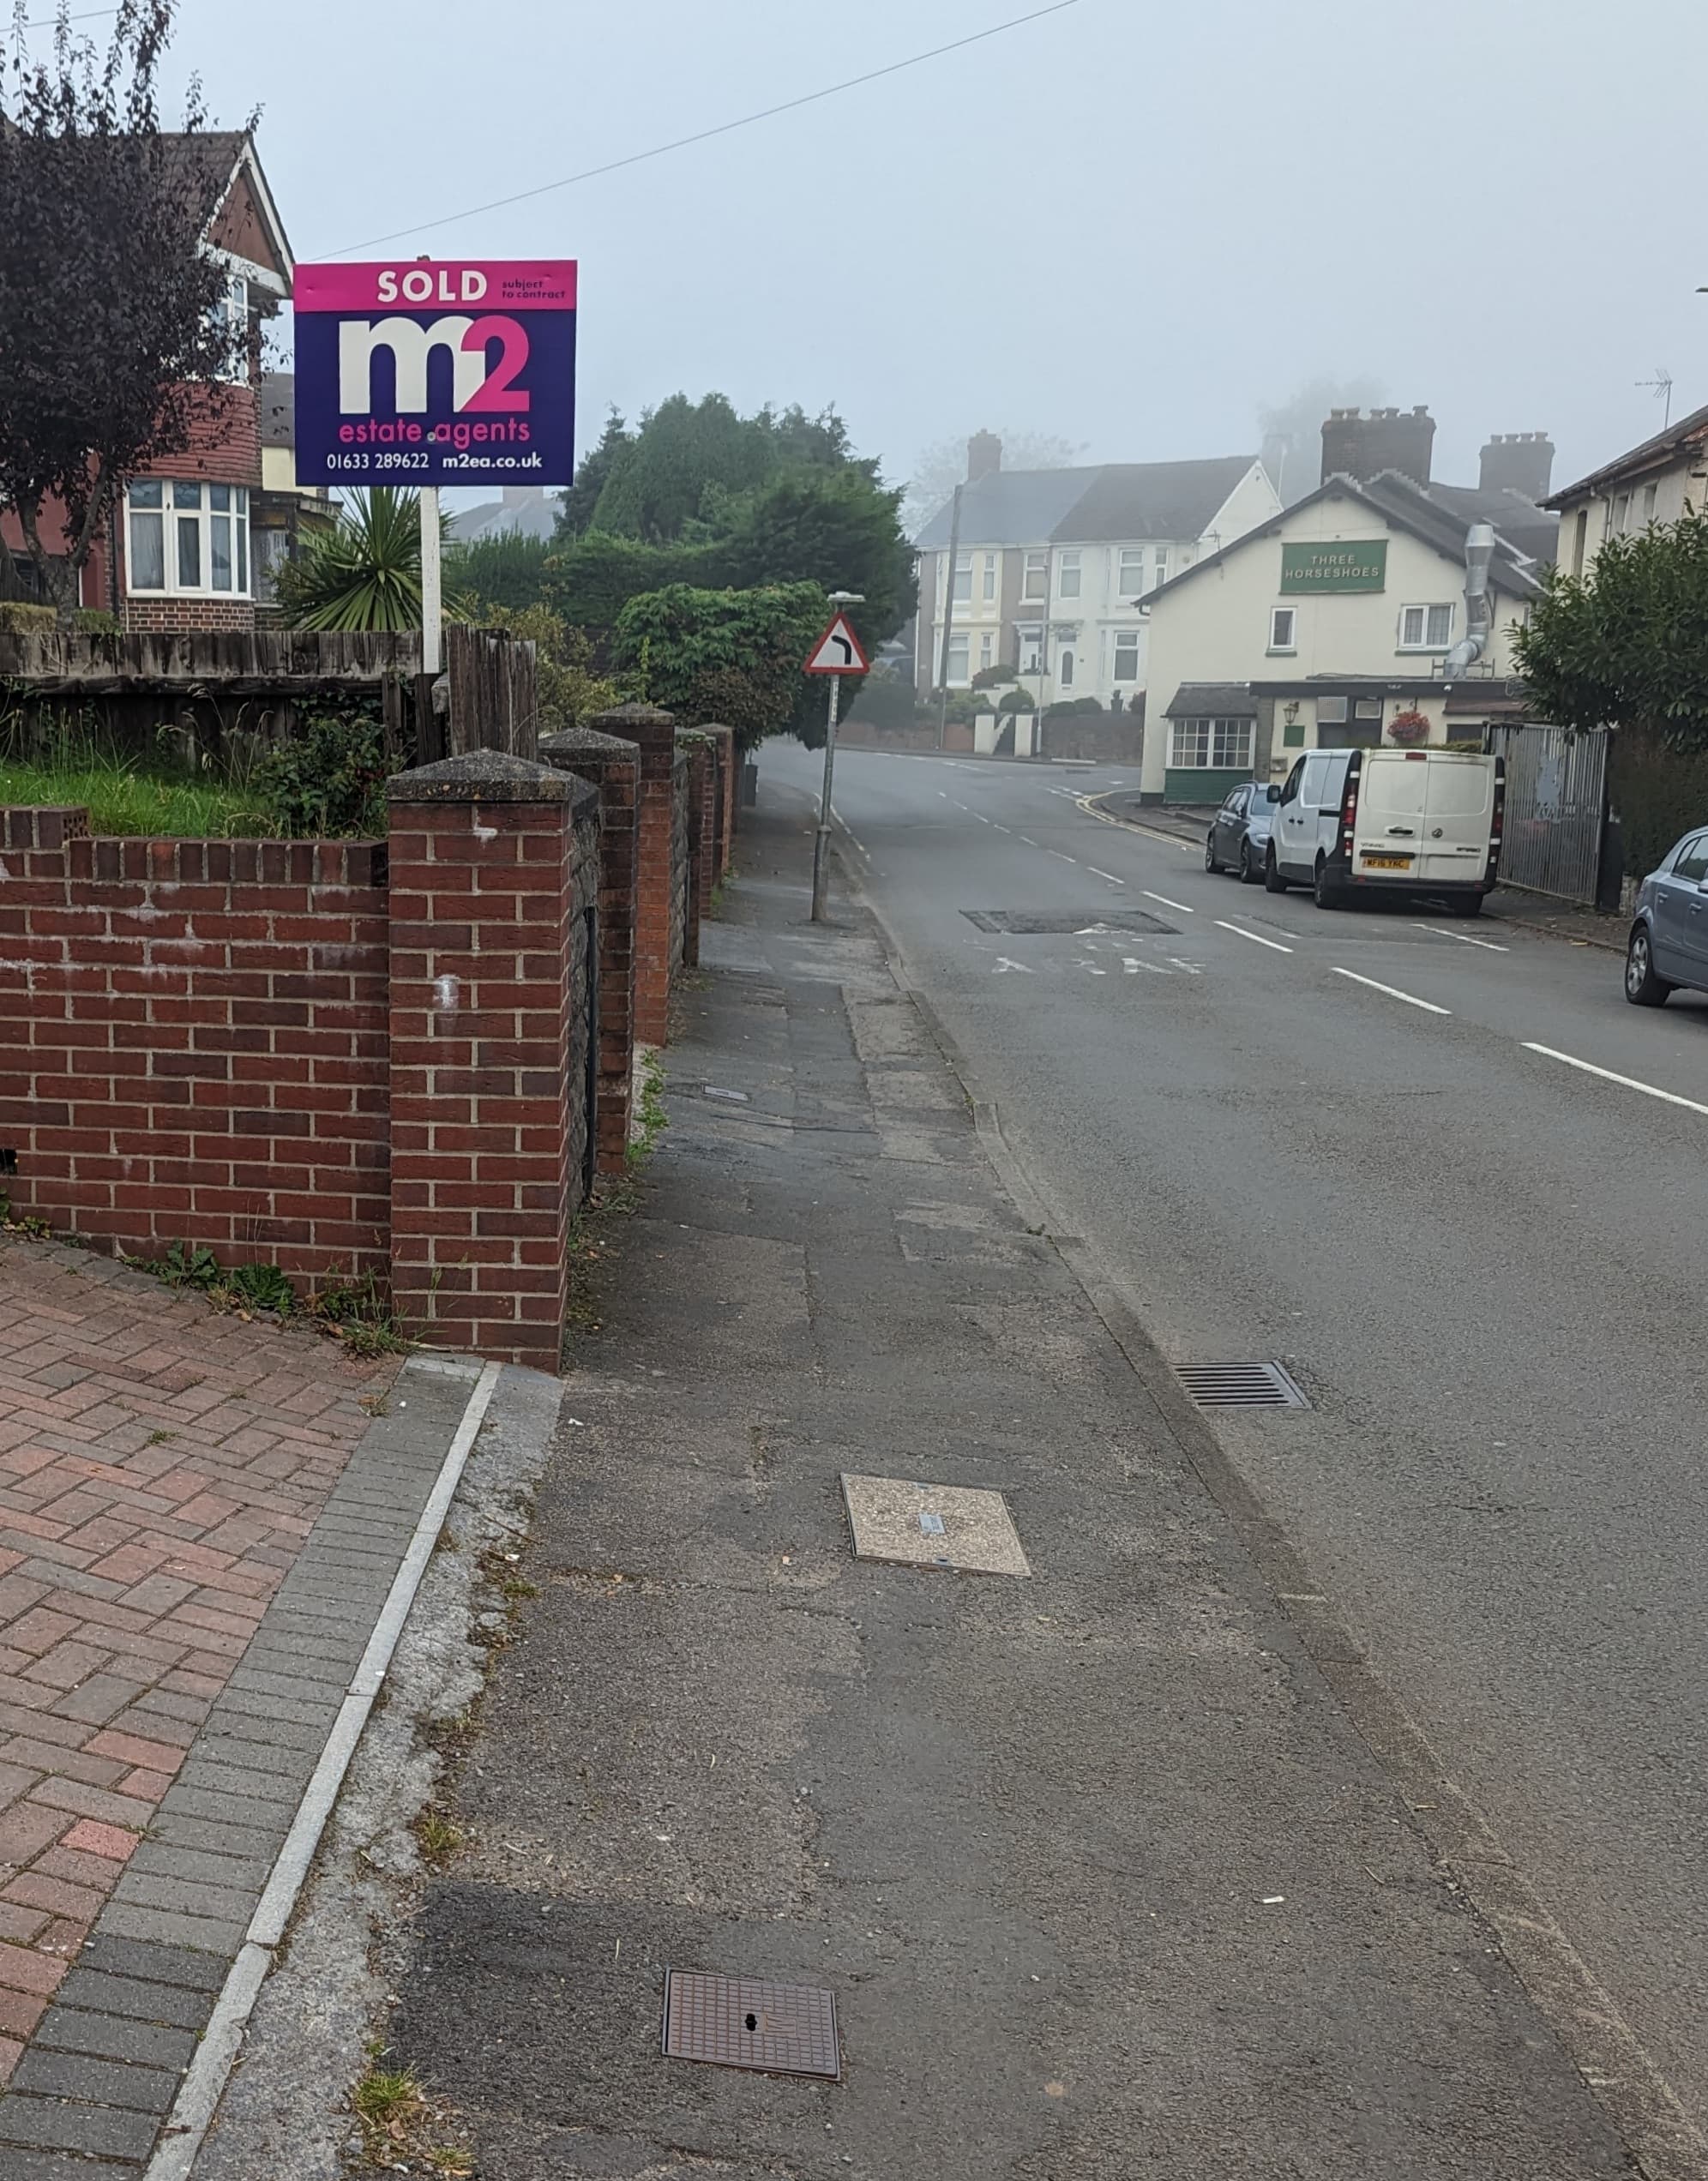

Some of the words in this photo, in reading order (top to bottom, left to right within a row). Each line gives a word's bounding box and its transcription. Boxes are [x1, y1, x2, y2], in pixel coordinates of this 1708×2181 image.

[377, 270, 487, 303] SOLD
[502, 279, 543, 291] subject
[516, 290, 565, 298] contract
[339, 315, 530, 414] m2
[339, 419, 422, 442] estate
[434, 418, 530, 449] agents
[327, 453, 370, 469] 01633
[375, 453, 430, 469] 289622
[442, 452, 543, 468] m2ea.co.uk
[1310, 555, 1356, 565] THREE
[1284, 567, 1380, 579] HORSESHOES
